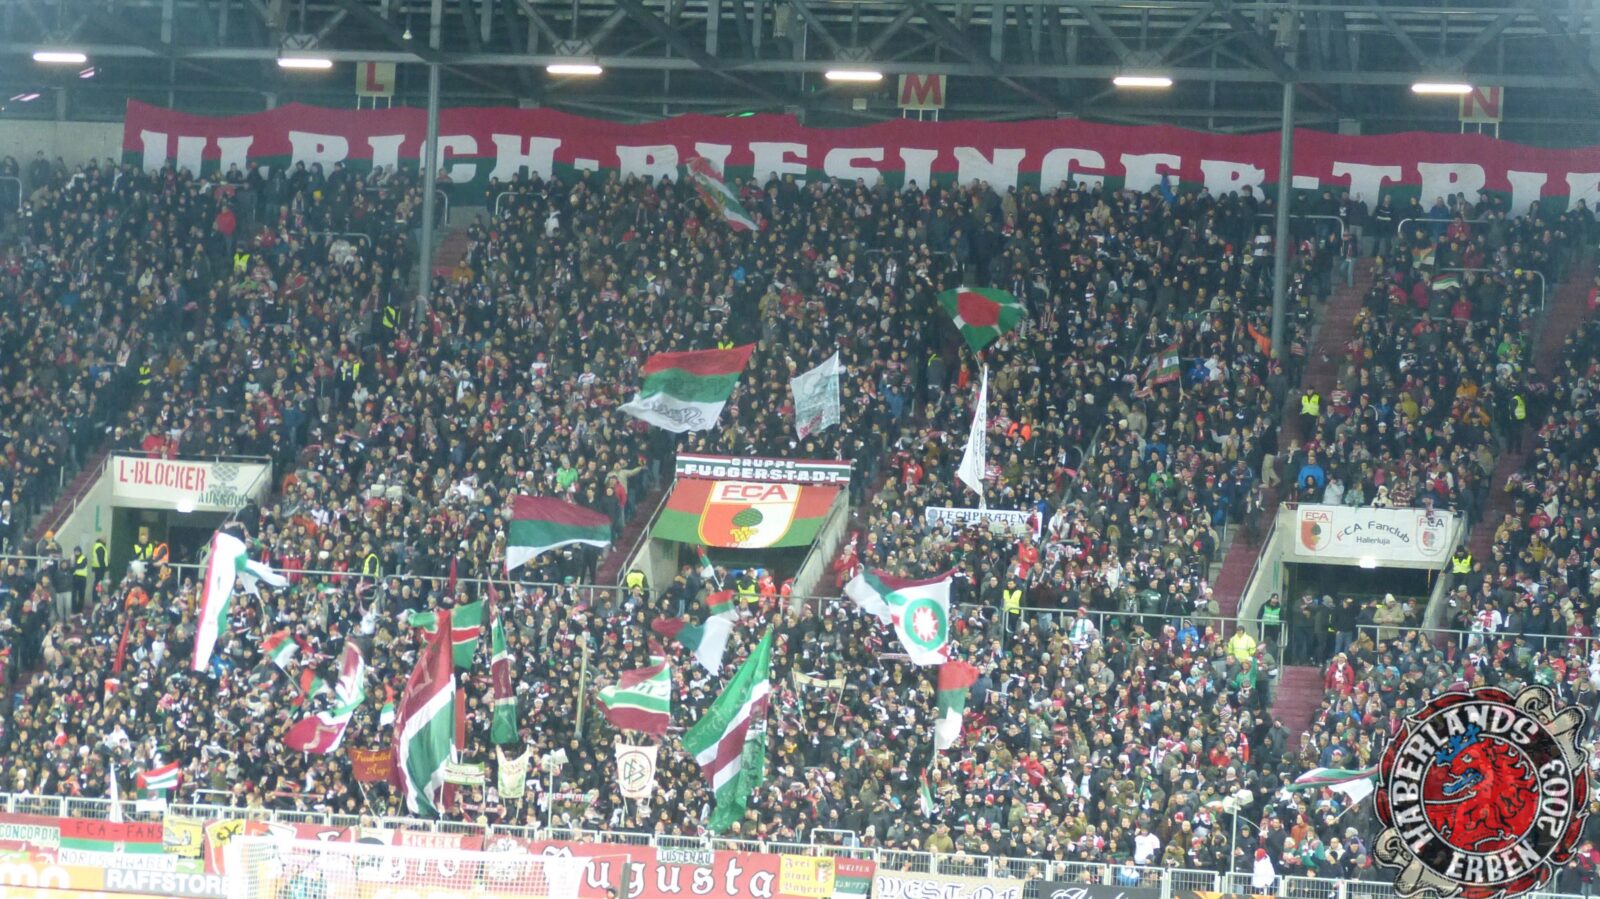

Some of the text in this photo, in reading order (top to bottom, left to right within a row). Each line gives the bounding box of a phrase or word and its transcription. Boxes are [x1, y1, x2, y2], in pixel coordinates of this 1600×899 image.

[366, 62, 385, 91] L
[902, 74, 942, 106] M
[1463, 87, 1499, 118] N
[731, 458, 796, 469] GRUPPE
[721, 484, 788, 500] FCA
[1305, 511, 1329, 521] FCA
[1336, 520, 1410, 543] FCA Fanclub
[0, 824, 59, 842] CONCORDIA
[75, 821, 106, 837] FCA
[127, 824, 163, 840] FANS
[661, 851, 711, 864] LUSTENAU
